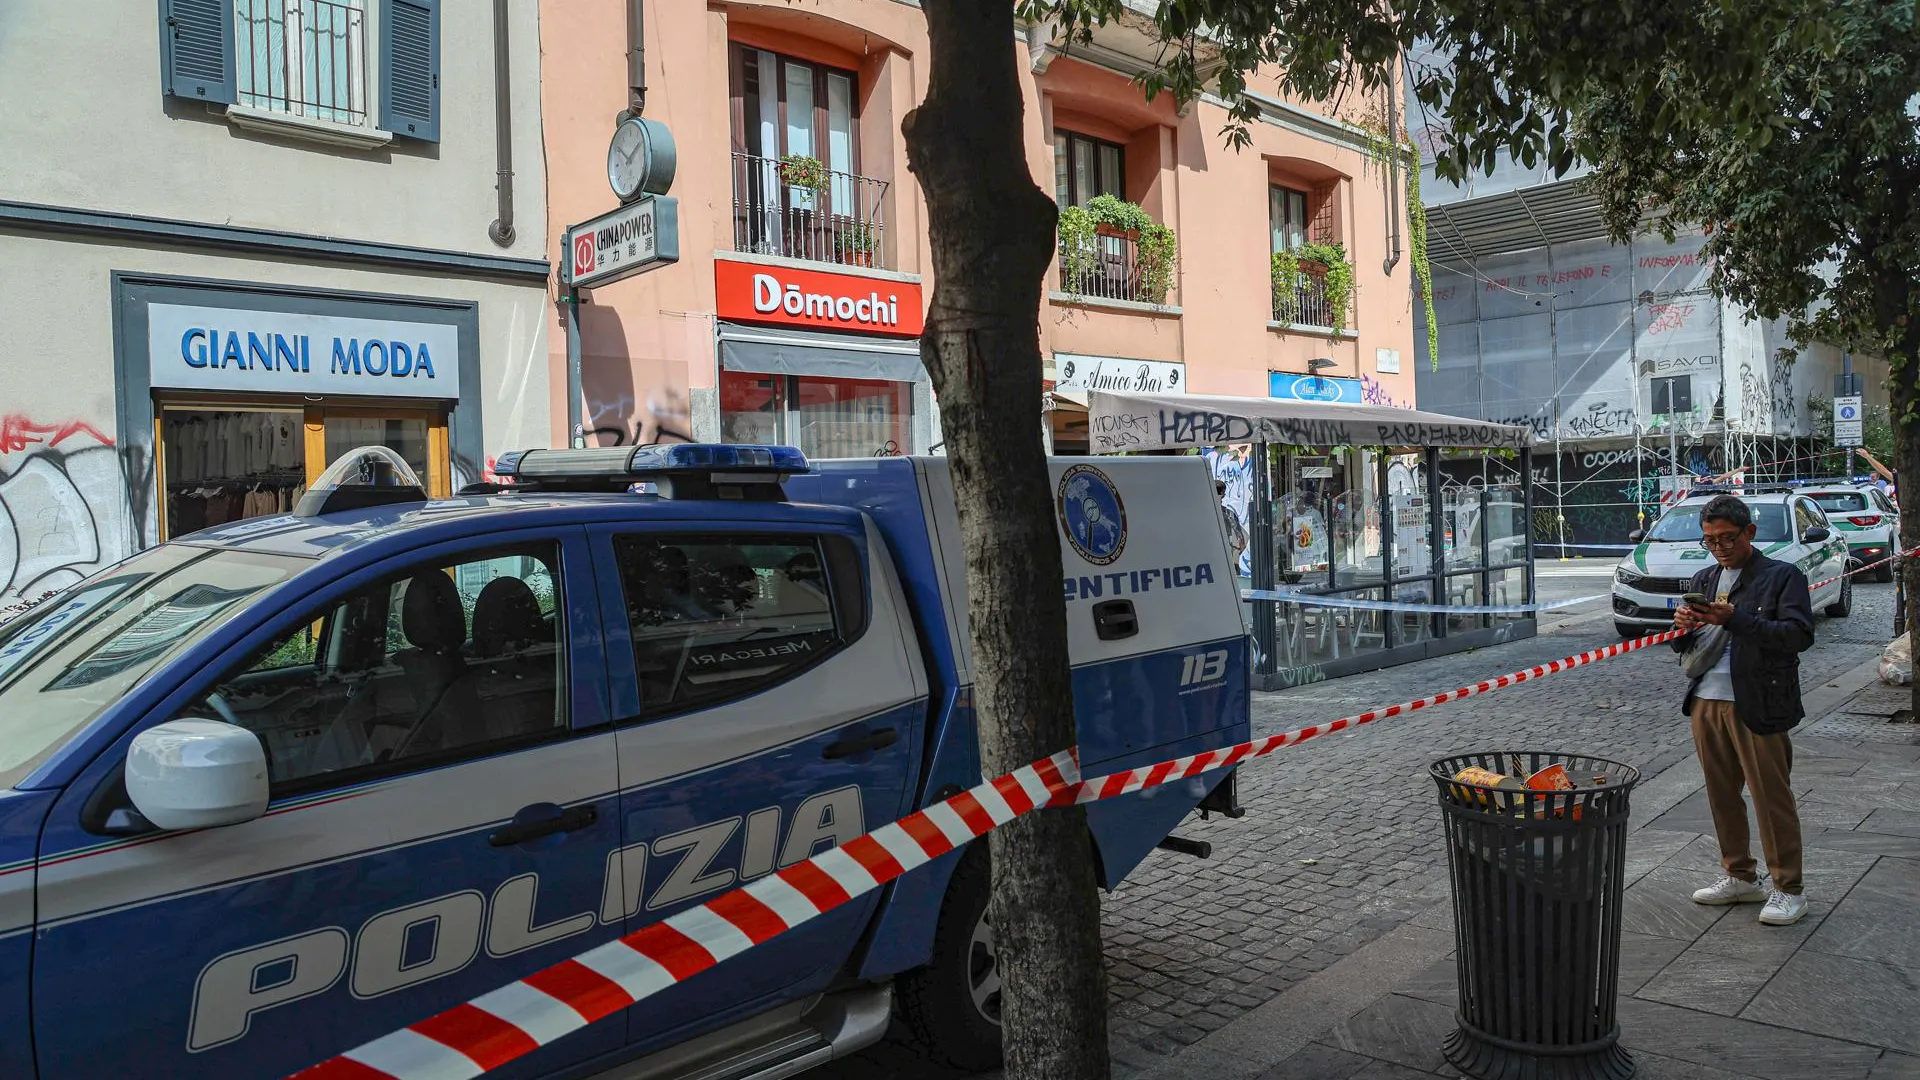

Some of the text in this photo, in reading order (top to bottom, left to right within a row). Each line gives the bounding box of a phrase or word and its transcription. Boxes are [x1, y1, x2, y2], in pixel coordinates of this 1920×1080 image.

[596, 212, 652, 251] CHINAPOWER
[597, 236, 653, 267] 华力能源
[754, 273, 897, 326] Dōmochi
[181, 327, 435, 379] GIANNI MODA
[1083, 361, 1162, 392] Amico Bar
[1058, 468, 1076, 498] POLIZIA
[1680, 579, 1691, 591] FIA
[1180, 650, 1228, 686] 113
[187, 784, 866, 1053] POLIZIA
